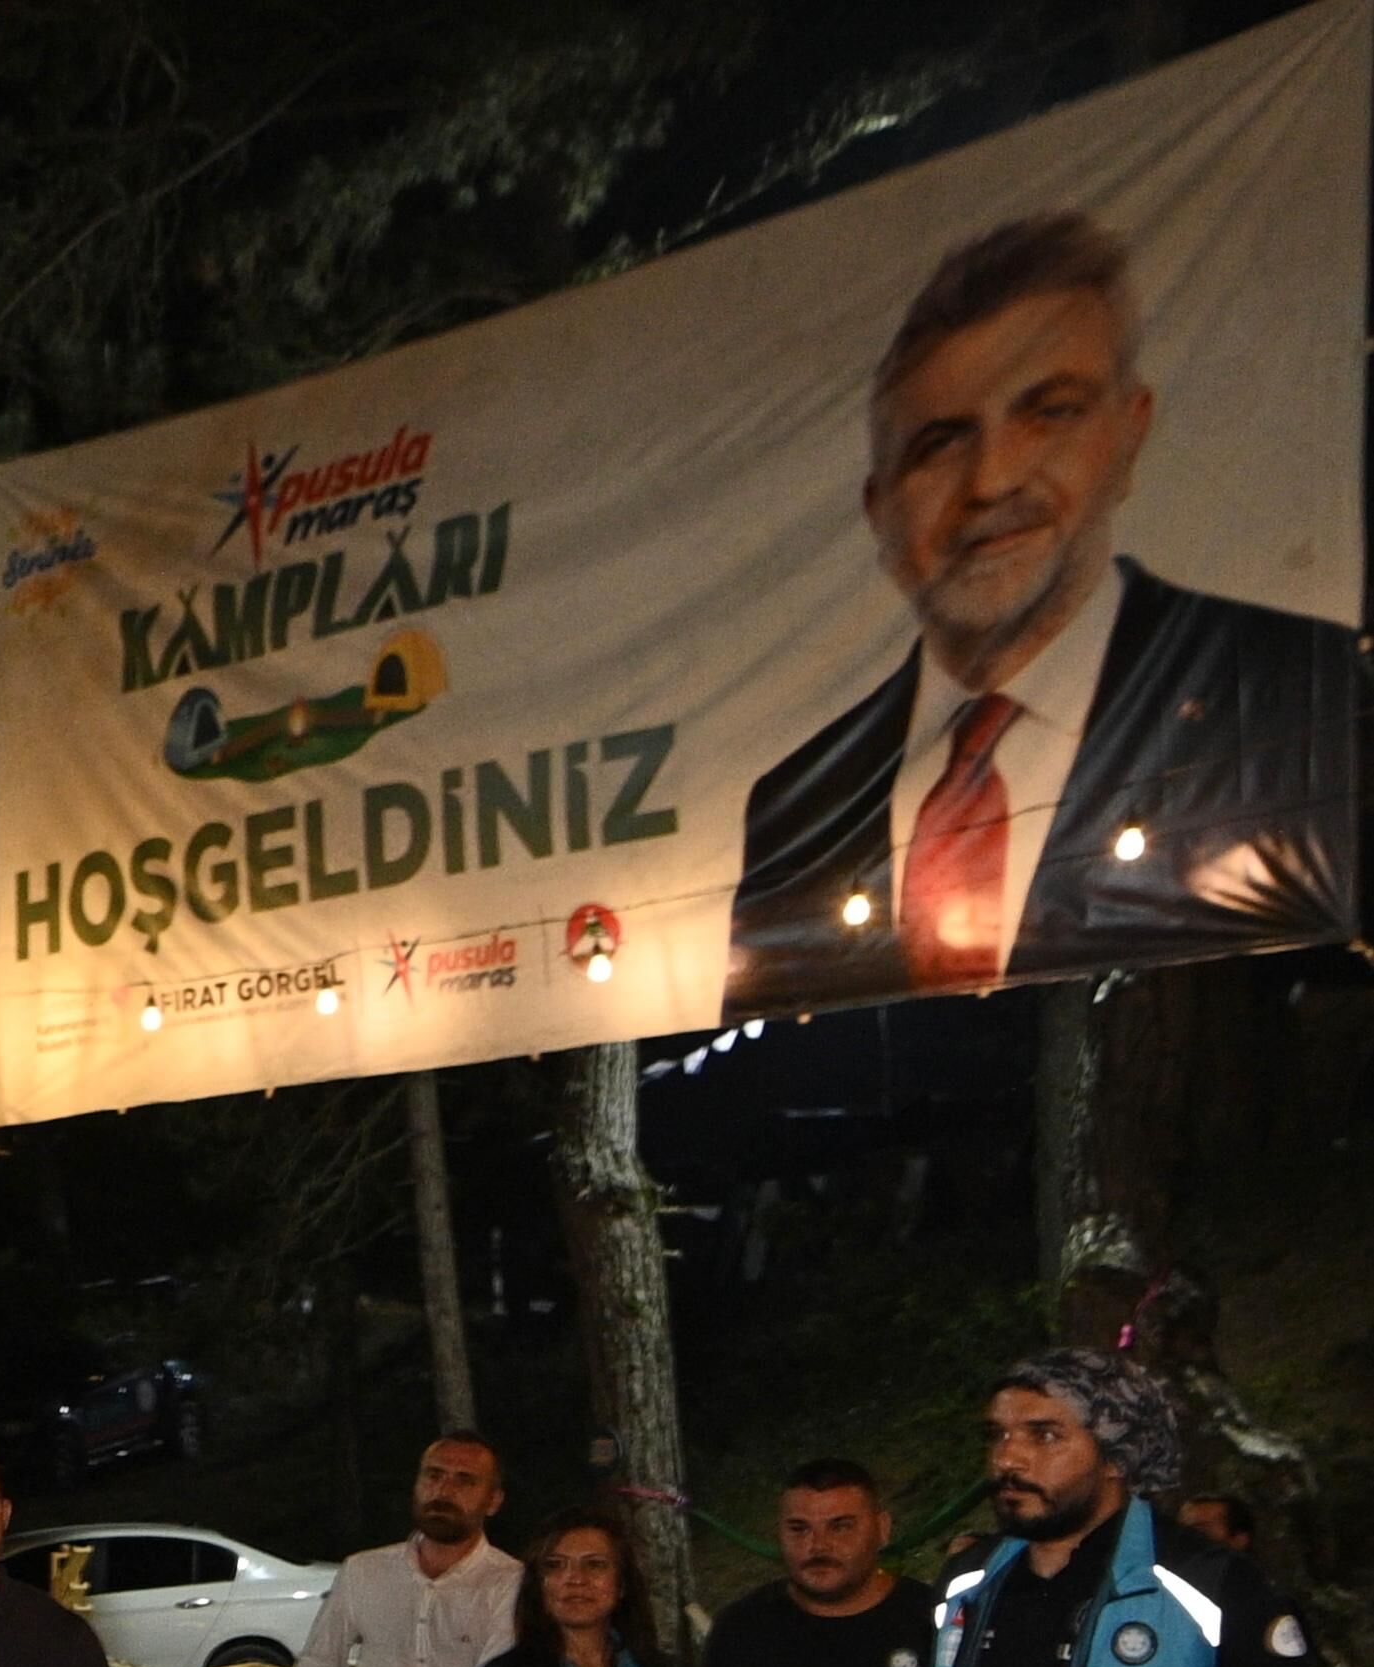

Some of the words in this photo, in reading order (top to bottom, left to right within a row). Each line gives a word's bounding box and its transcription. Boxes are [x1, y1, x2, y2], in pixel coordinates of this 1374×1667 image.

[269, 424, 432, 535] pusula
[120, 502, 511, 693] KAMPLARI
[14, 723, 679, 961] HOŞGELDİNİZ
[160, 981, 228, 1013] FIRAT
[426, 929, 517, 988] pusula
